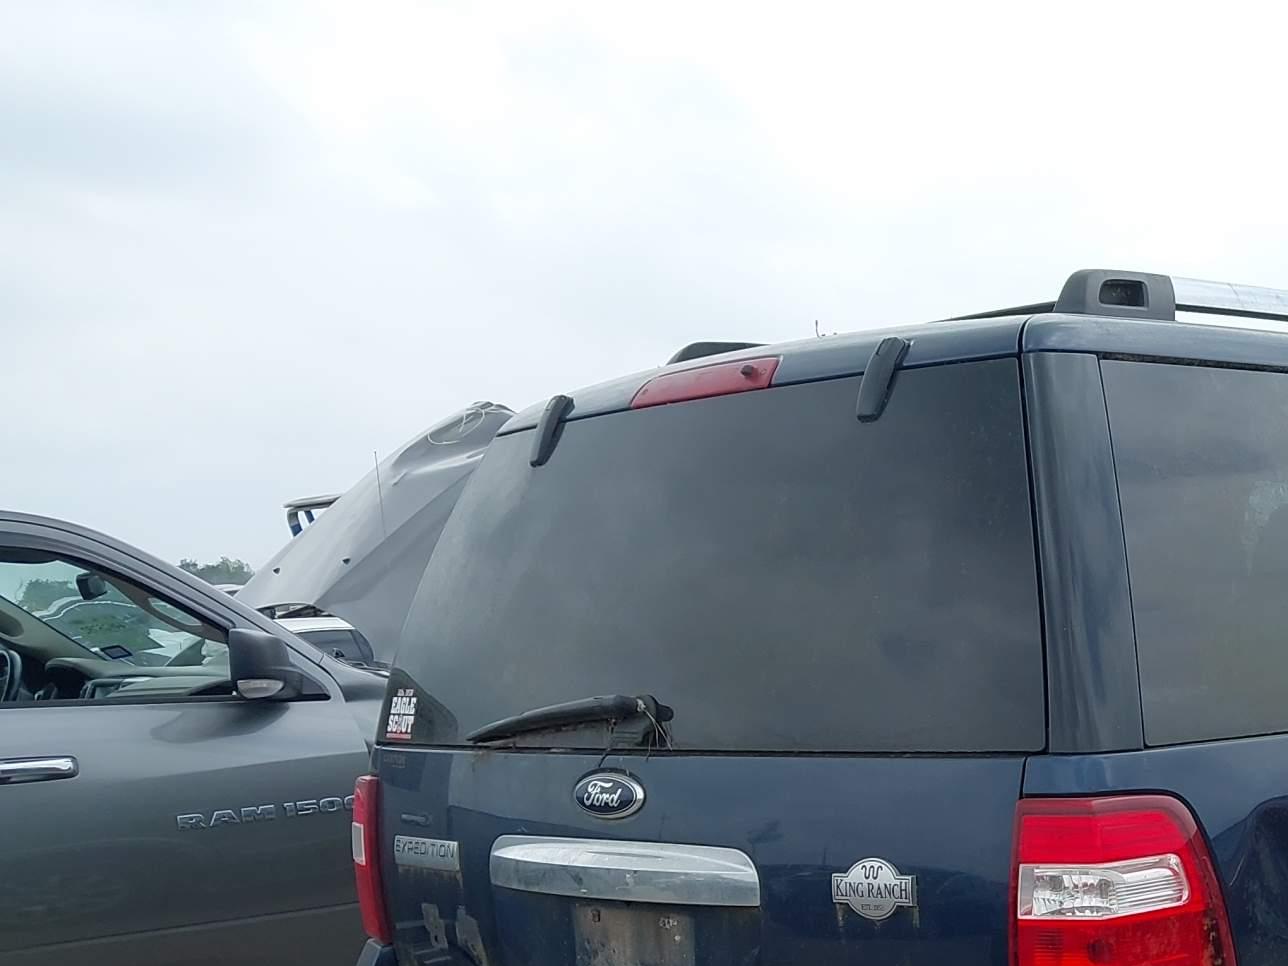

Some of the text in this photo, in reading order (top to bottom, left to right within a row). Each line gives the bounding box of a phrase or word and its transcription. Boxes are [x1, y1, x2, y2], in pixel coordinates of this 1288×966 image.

[390, 696, 417, 714] EAGLE
[583, 780, 622, 807] Ford
[176, 804, 276, 830] RAM
[395, 838, 456, 858] EXPEDITION
[835, 878, 908, 900] KING RANCH
